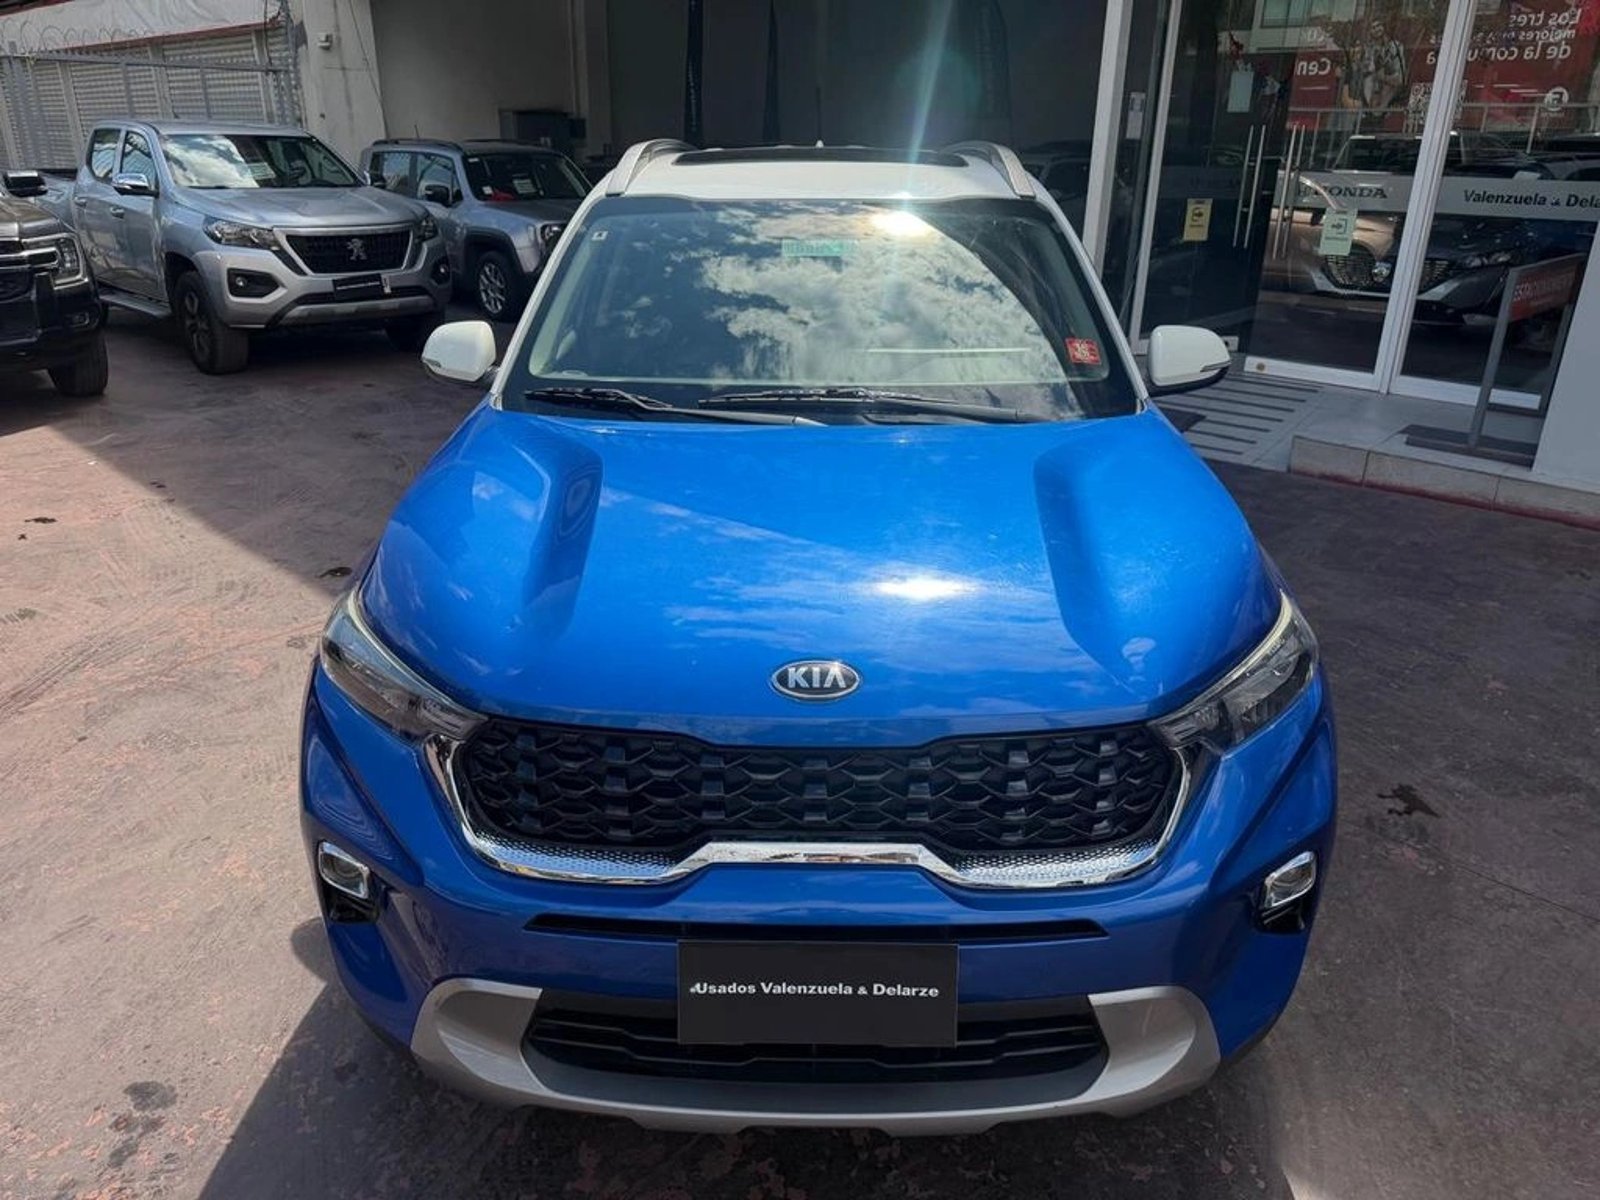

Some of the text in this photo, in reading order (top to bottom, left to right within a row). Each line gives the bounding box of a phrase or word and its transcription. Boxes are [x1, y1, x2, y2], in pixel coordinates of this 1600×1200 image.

[1463, 189, 1548, 206] Valenzuela
[787, 666, 847, 689] KIA
[695, 982, 939, 998] Usados Valenzuela & Delarze
